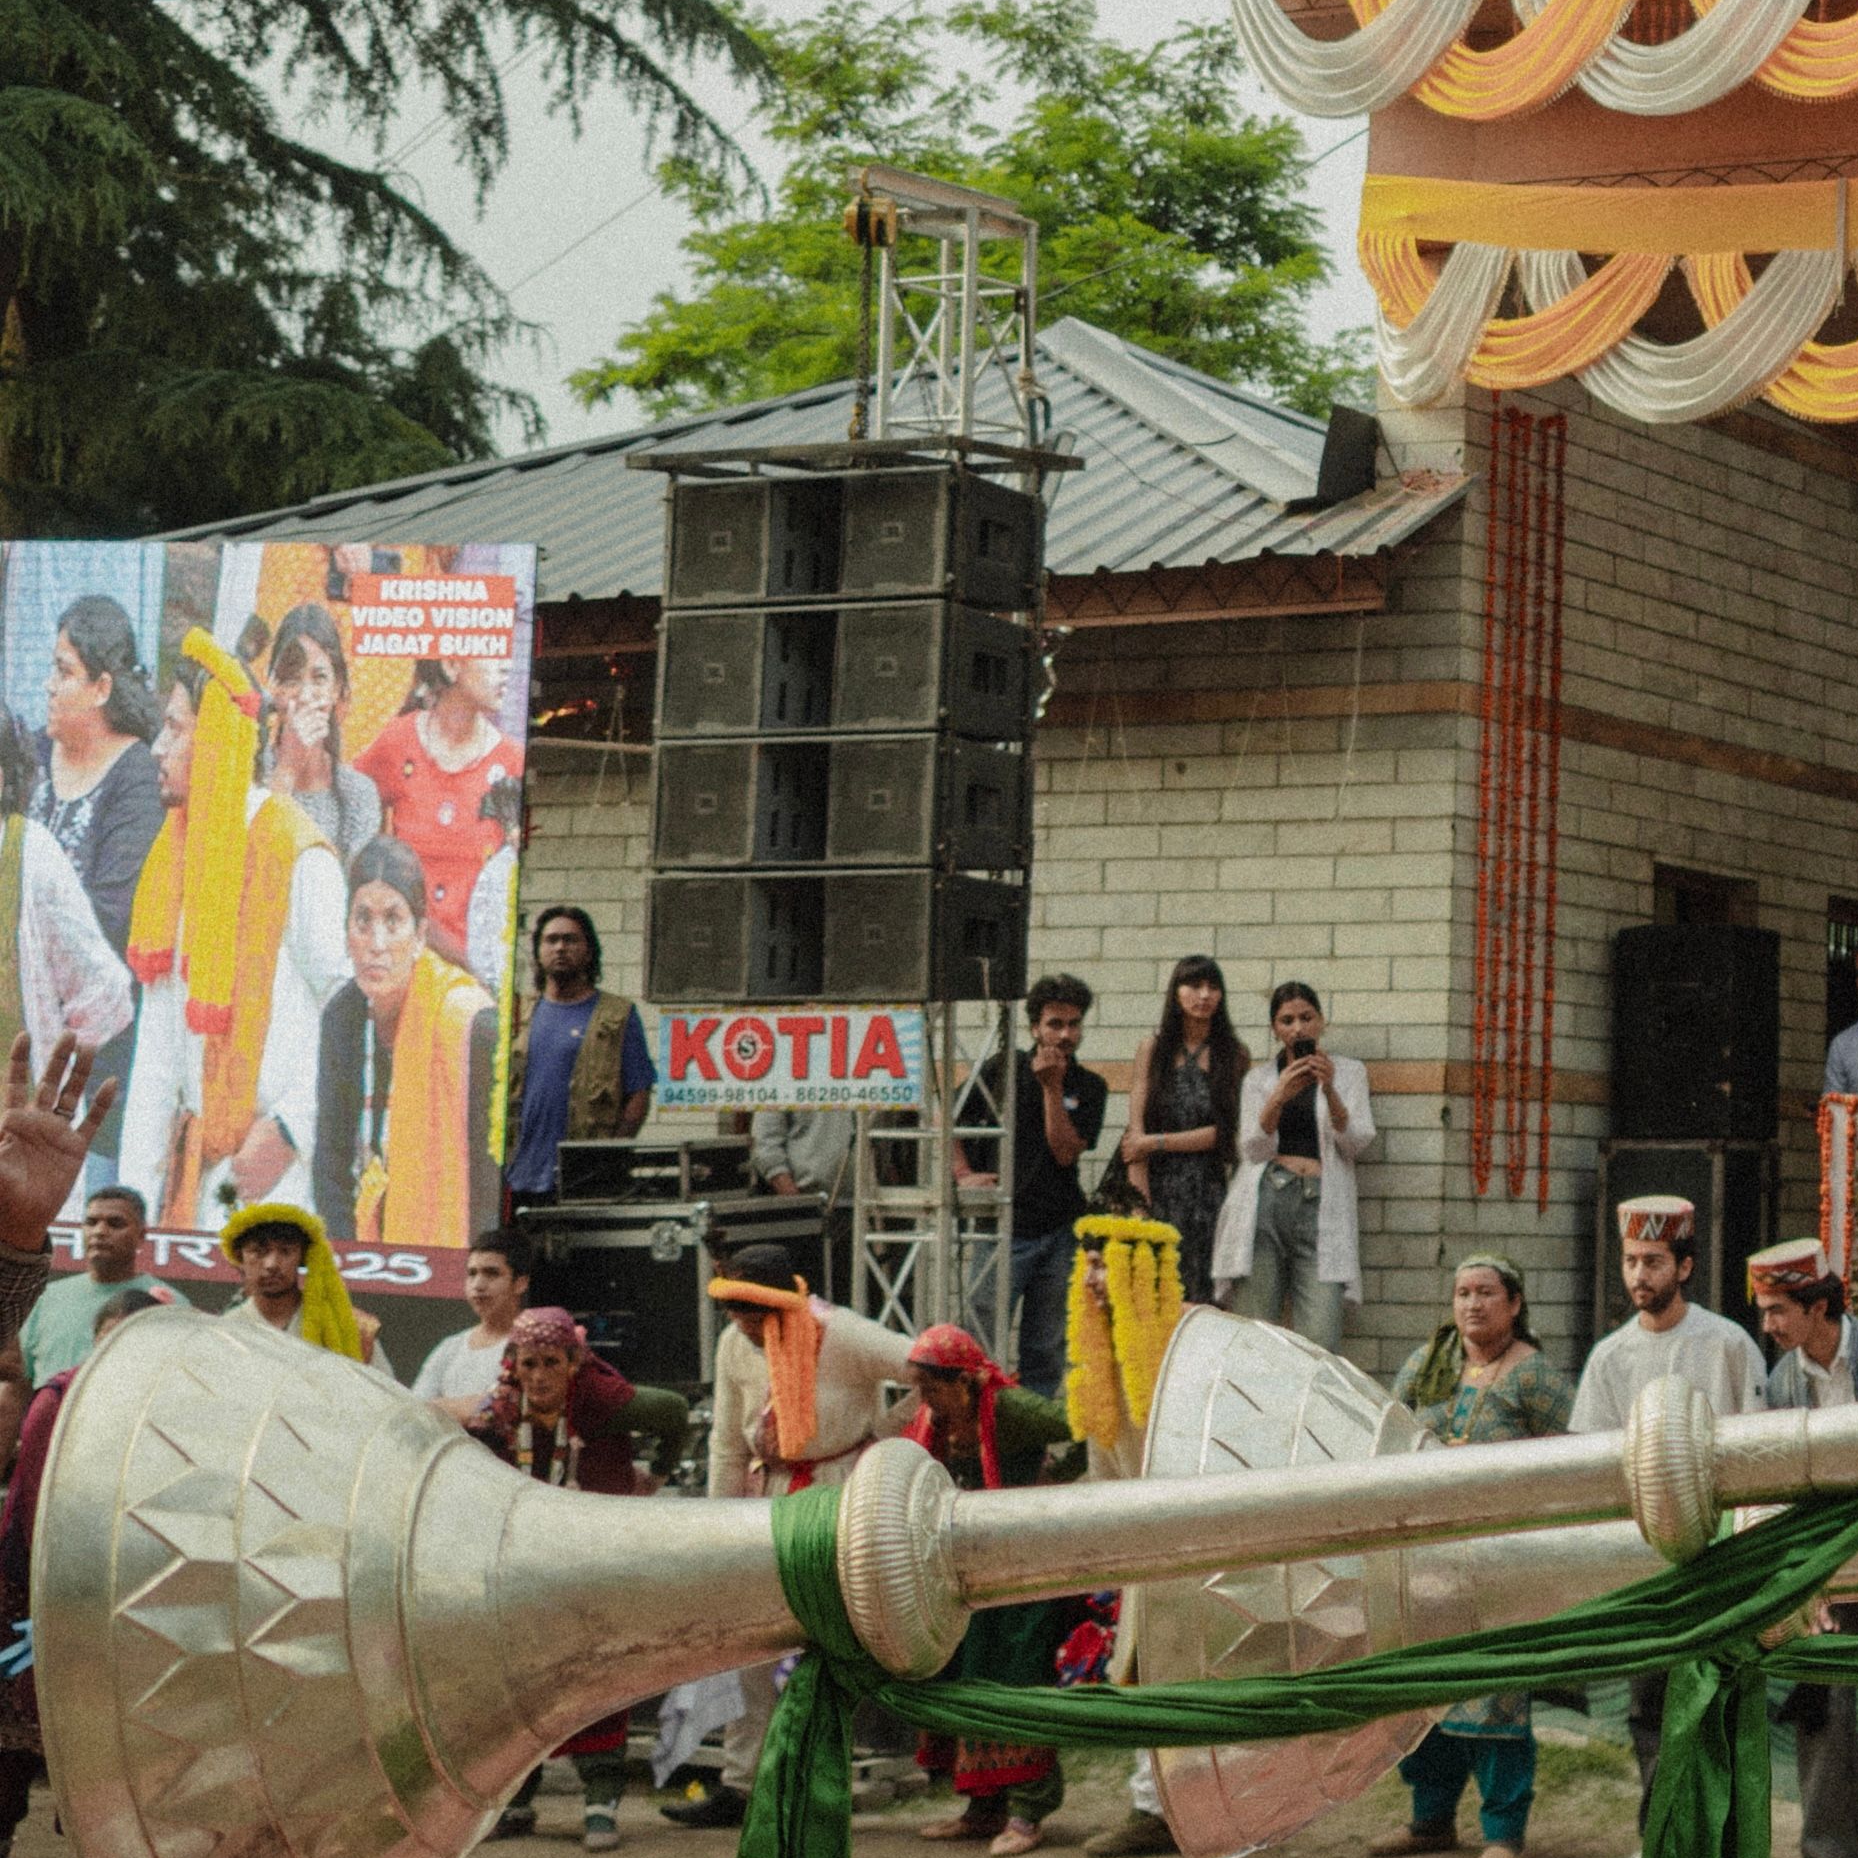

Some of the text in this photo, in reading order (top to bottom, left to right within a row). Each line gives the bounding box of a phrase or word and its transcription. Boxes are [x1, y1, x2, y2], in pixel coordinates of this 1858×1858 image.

[379, 578, 489, 602] KRISHNA
[351, 605, 515, 629] VIDEO VISION
[356, 632, 507, 657] JAGAT SUKH
[669, 1015, 907, 1081] KOTIA
